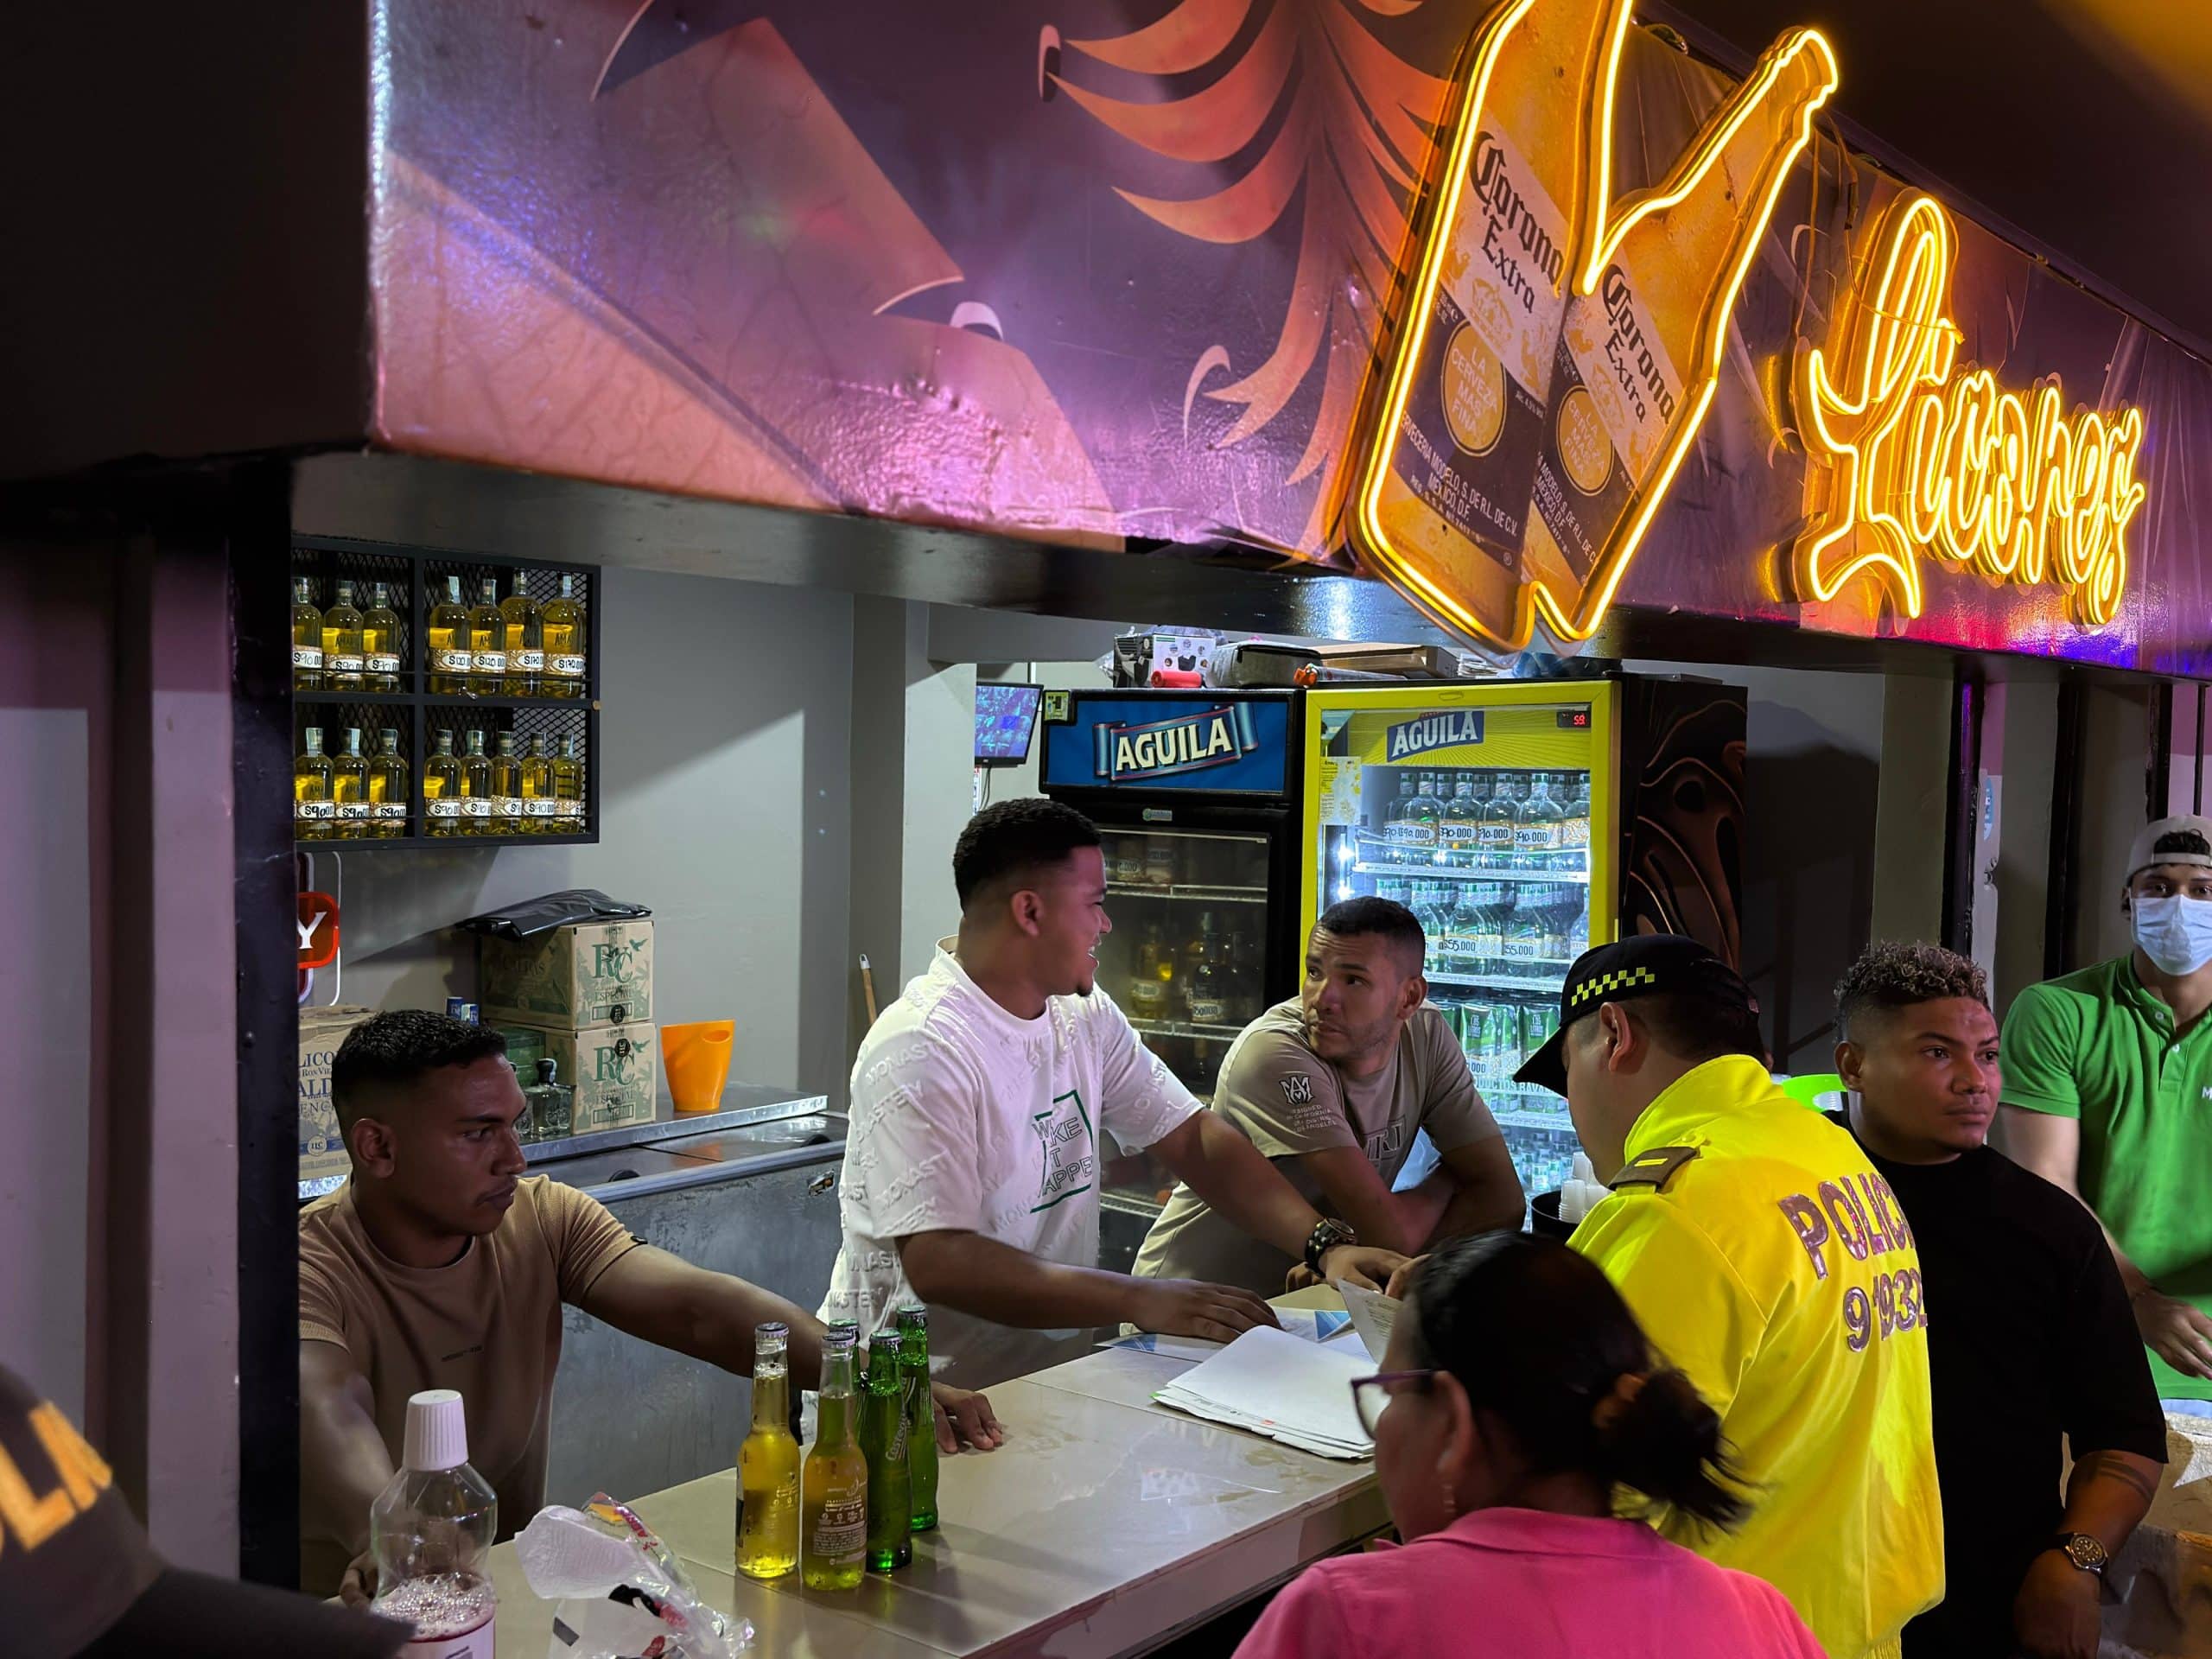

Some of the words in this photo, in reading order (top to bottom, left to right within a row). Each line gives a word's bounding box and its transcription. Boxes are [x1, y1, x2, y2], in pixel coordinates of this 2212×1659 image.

[1470, 130, 1565, 286] Corona
[1481, 214, 1535, 314] Extra
[1471, 348, 1486, 373] LA
[1602, 264, 1675, 424] Corona
[1452, 347, 1498, 413] CERVEZA
[1458, 380, 1481, 417] MAS
[1605, 329, 1646, 423] Extra
[1452, 398, 1478, 432] FINA
[1568, 400, 1605, 471] CERVEZA
[1586, 412, 1598, 435] LA
[1402, 410, 1433, 464] ERVECERIA
[1469, 488, 1481, 508] DE
[1565, 437, 1584, 474] FINA
[1116, 717, 1235, 772] AGUILA
[1392, 710, 1478, 758] AGUILA
[299, 1051, 334, 1068] ICO
[1038, 1155, 1092, 1198] APPE
